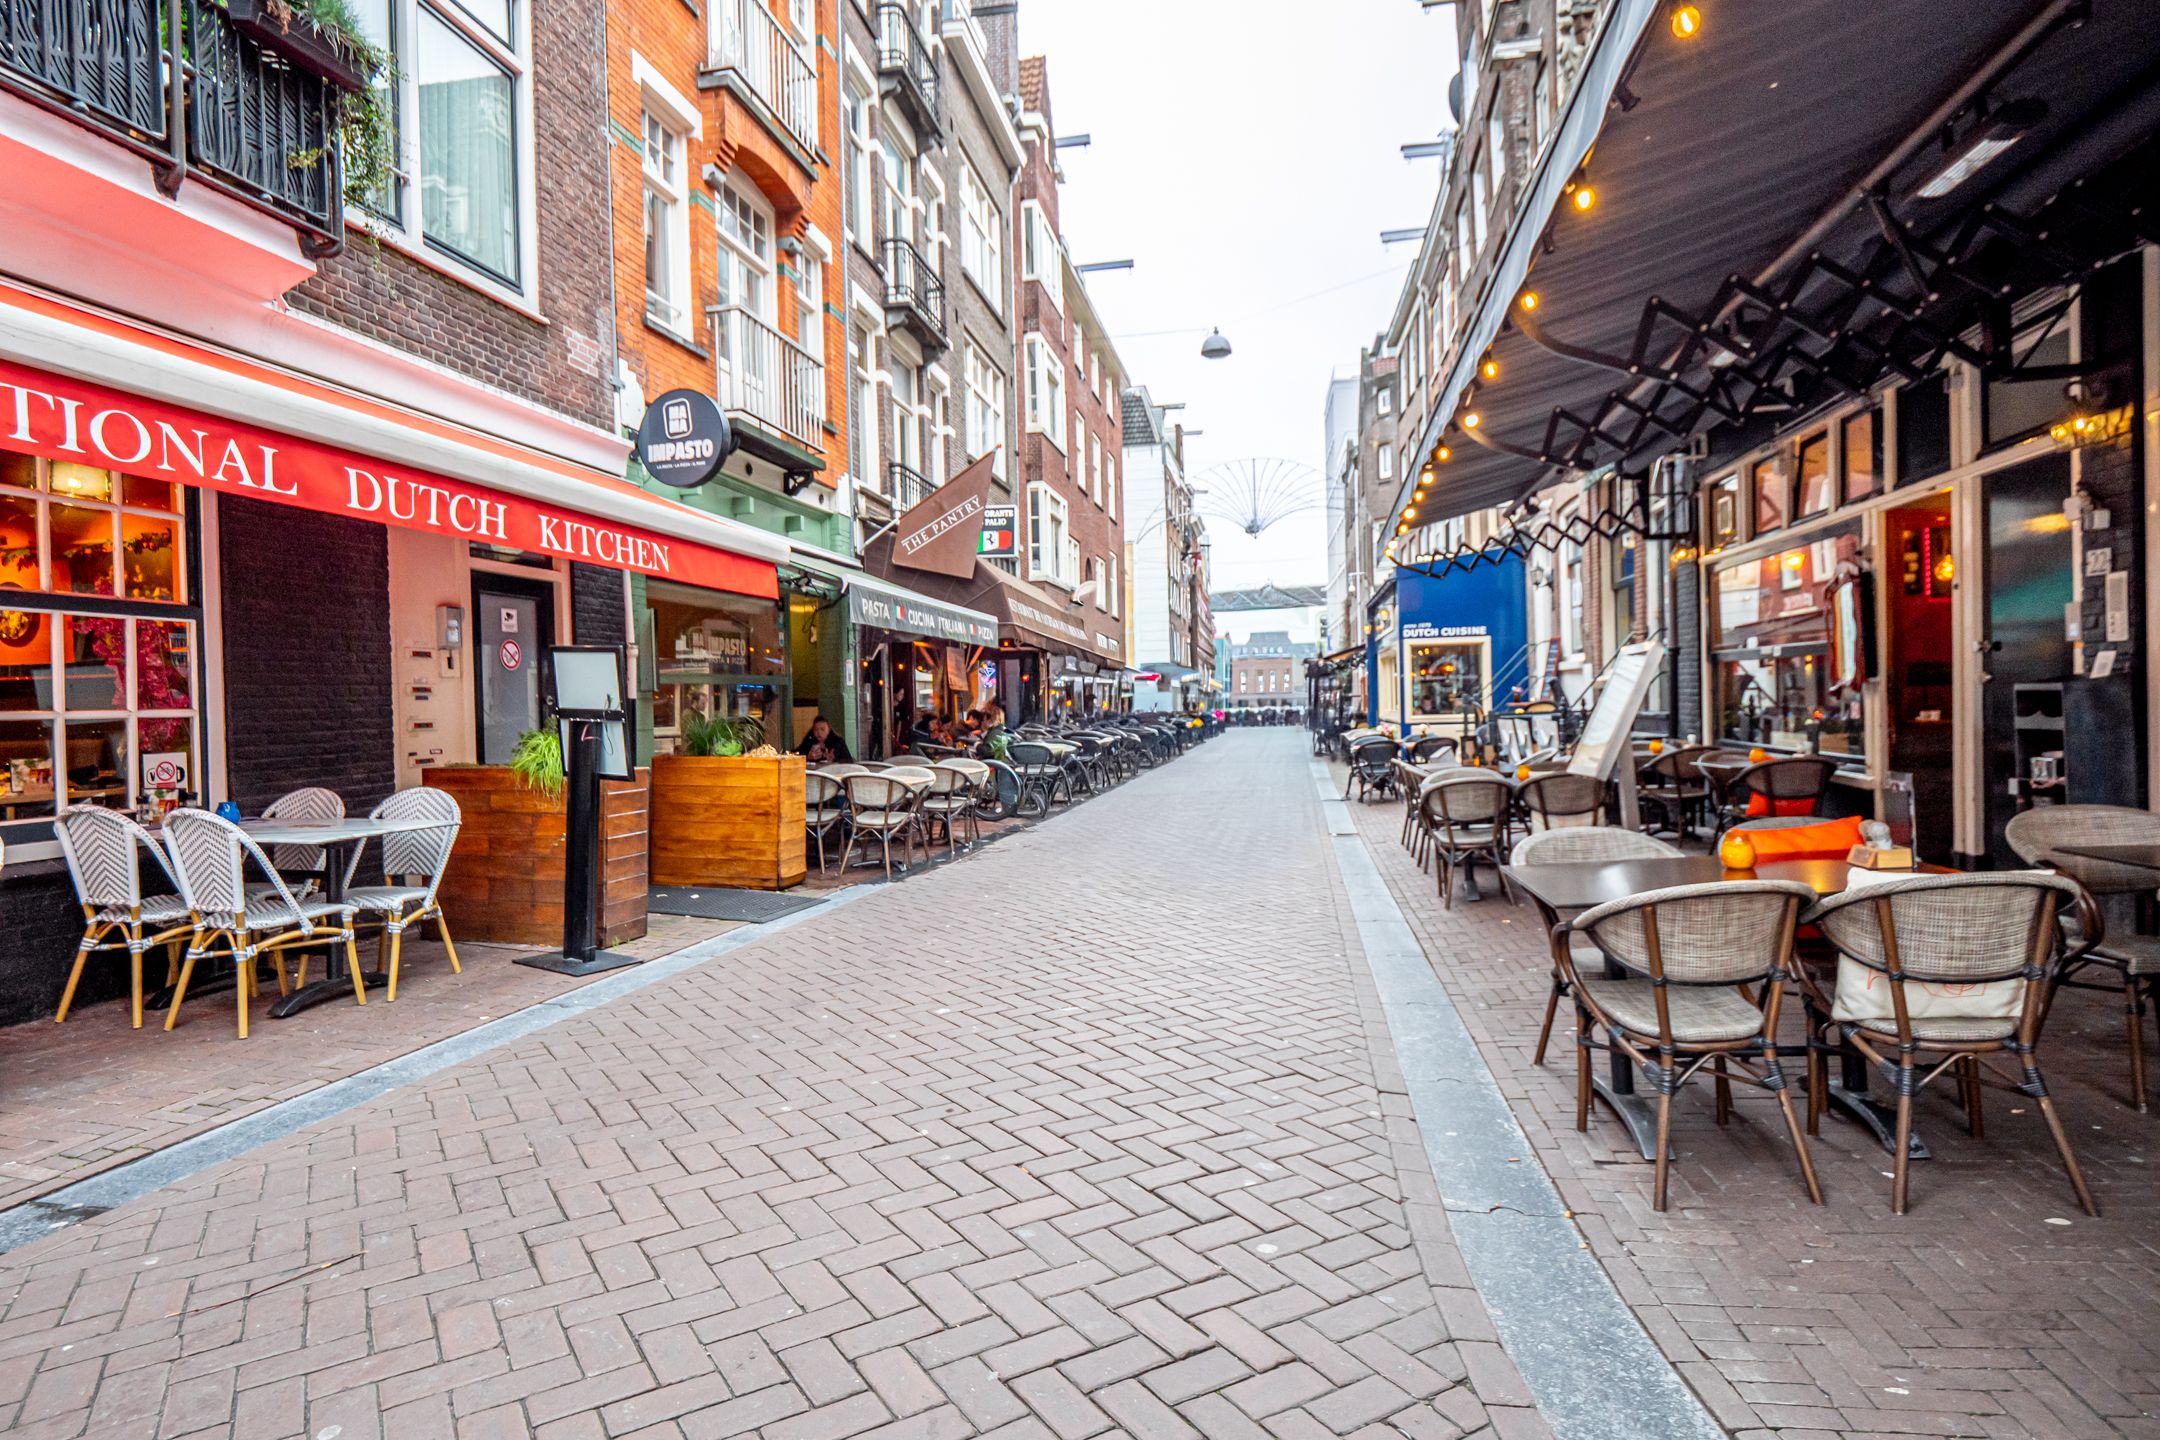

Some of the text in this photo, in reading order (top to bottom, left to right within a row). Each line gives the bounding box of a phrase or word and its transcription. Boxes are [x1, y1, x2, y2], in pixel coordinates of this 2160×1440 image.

[647, 438, 714, 463] IMPASTO
[0, 382, 671, 573] TIONAL DUTCH KITCHEN
[902, 496, 981, 552] THE PANTRY
[861, 598, 994, 641] PASTA CUCINA ITALIANA PIZZA
[1402, 626, 1487, 638] DUTCH CUISINE
